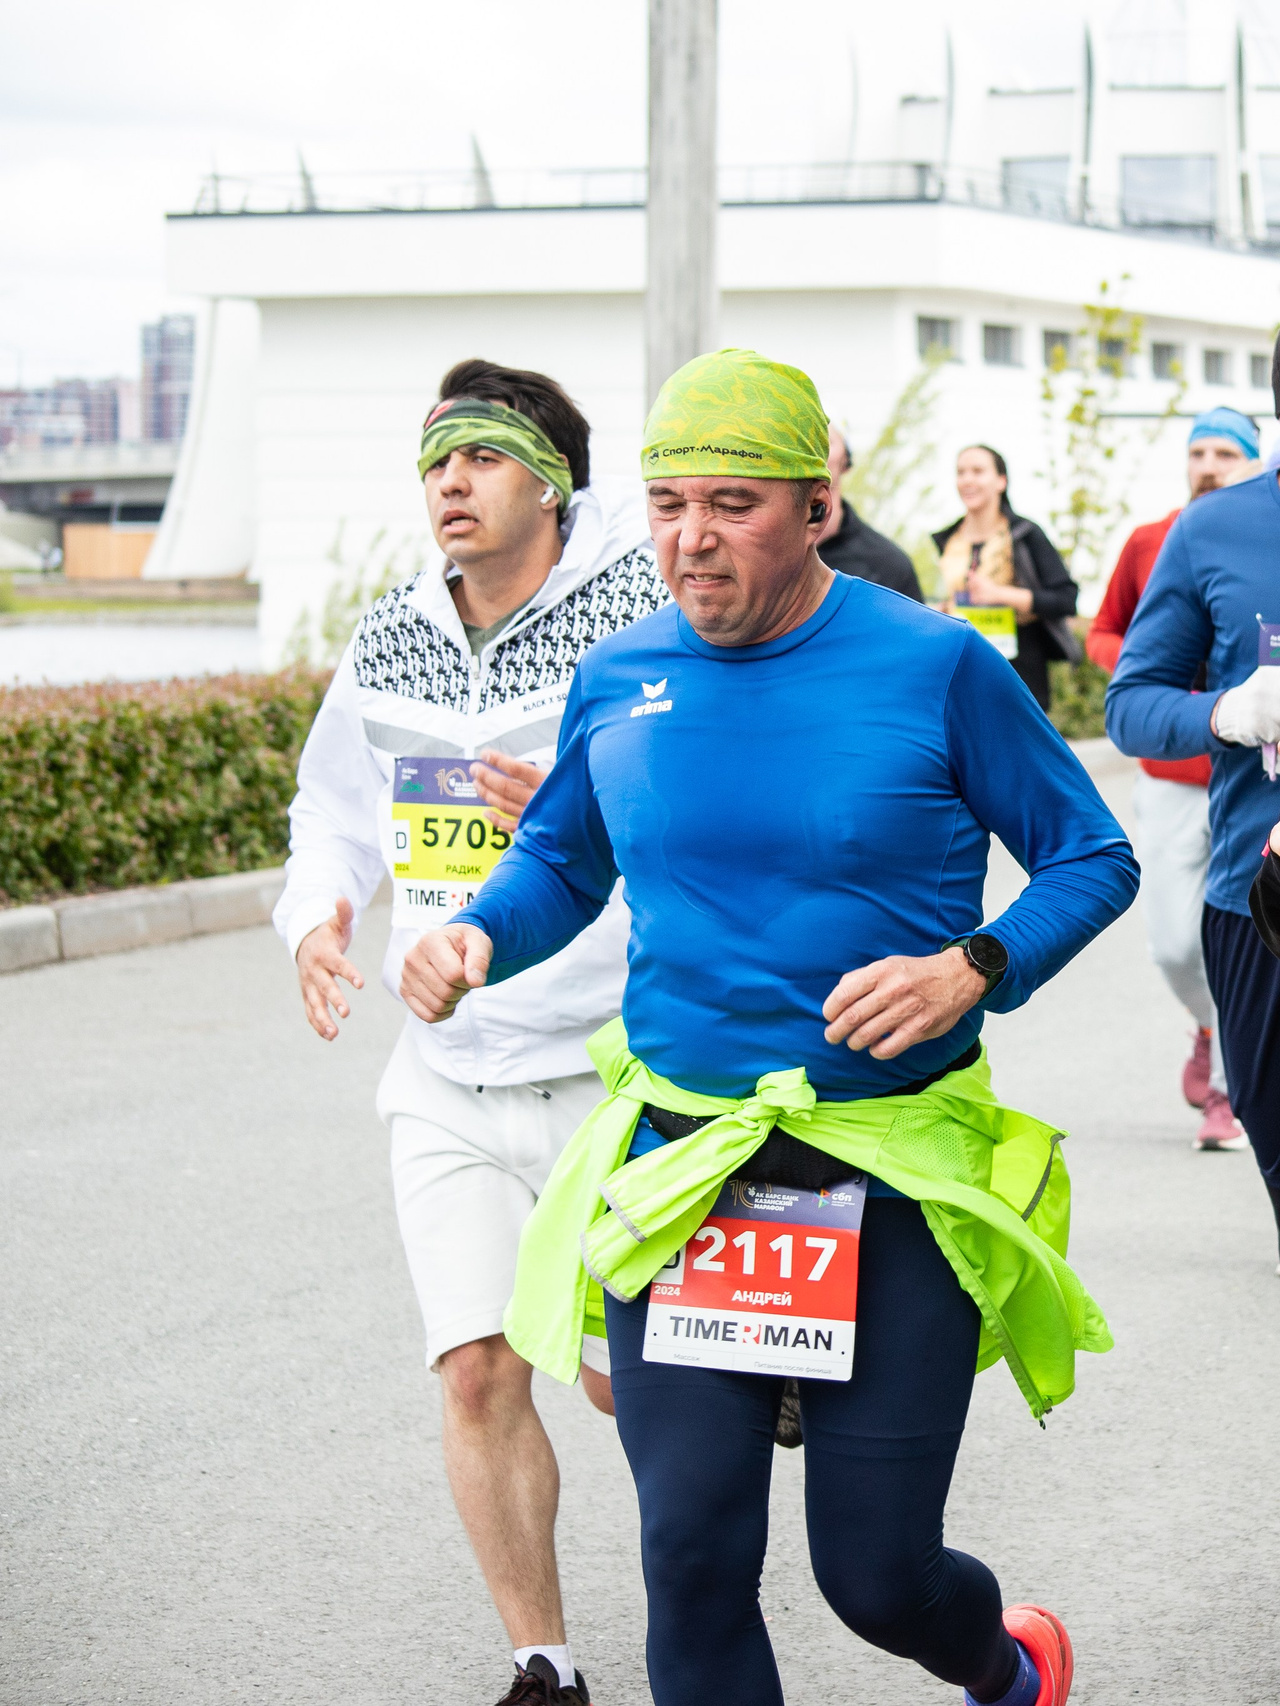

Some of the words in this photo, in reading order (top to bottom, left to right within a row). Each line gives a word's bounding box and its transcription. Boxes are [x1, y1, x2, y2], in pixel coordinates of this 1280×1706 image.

[522, 699, 546, 713] BLACK
[630, 700, 673, 718] erima
[395, 832, 407, 849] D
[445, 864, 483, 875] РАДИК
[754, 1198, 793, 1207] КАЗАНСКИЙ
[782, 1194, 799, 1202] БАНК
[831, 1192, 852, 1202] сбп
[753, 1203, 785, 1212] МАРАФОН
[692, 1226, 838, 1282] 2117
[654, 1285, 681, 1297] 2024
[731, 1290, 793, 1307] АНДРЕЙ
[669, 1316, 834, 1351] TIMERMAN
[753, 1361, 783, 1370] Питание
[804, 1366, 833, 1375] финиша
